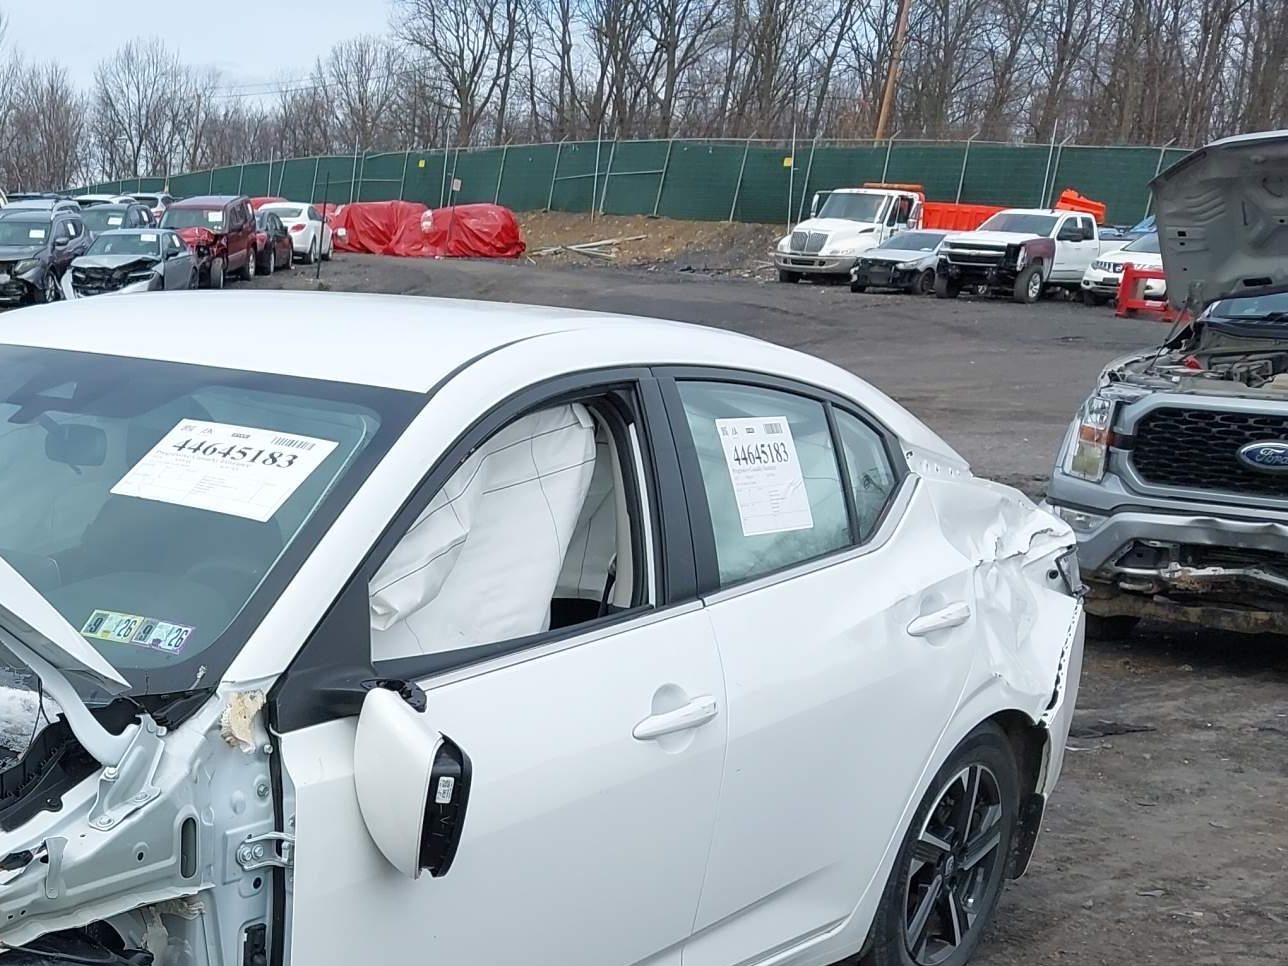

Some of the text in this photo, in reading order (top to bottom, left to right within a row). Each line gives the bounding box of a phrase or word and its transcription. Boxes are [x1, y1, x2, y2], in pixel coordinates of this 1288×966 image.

[172, 438, 298, 469] 44645183
[733, 442, 789, 466] 44645183
[117, 619, 137, 638] 26
[168, 629, 188, 648] 26
